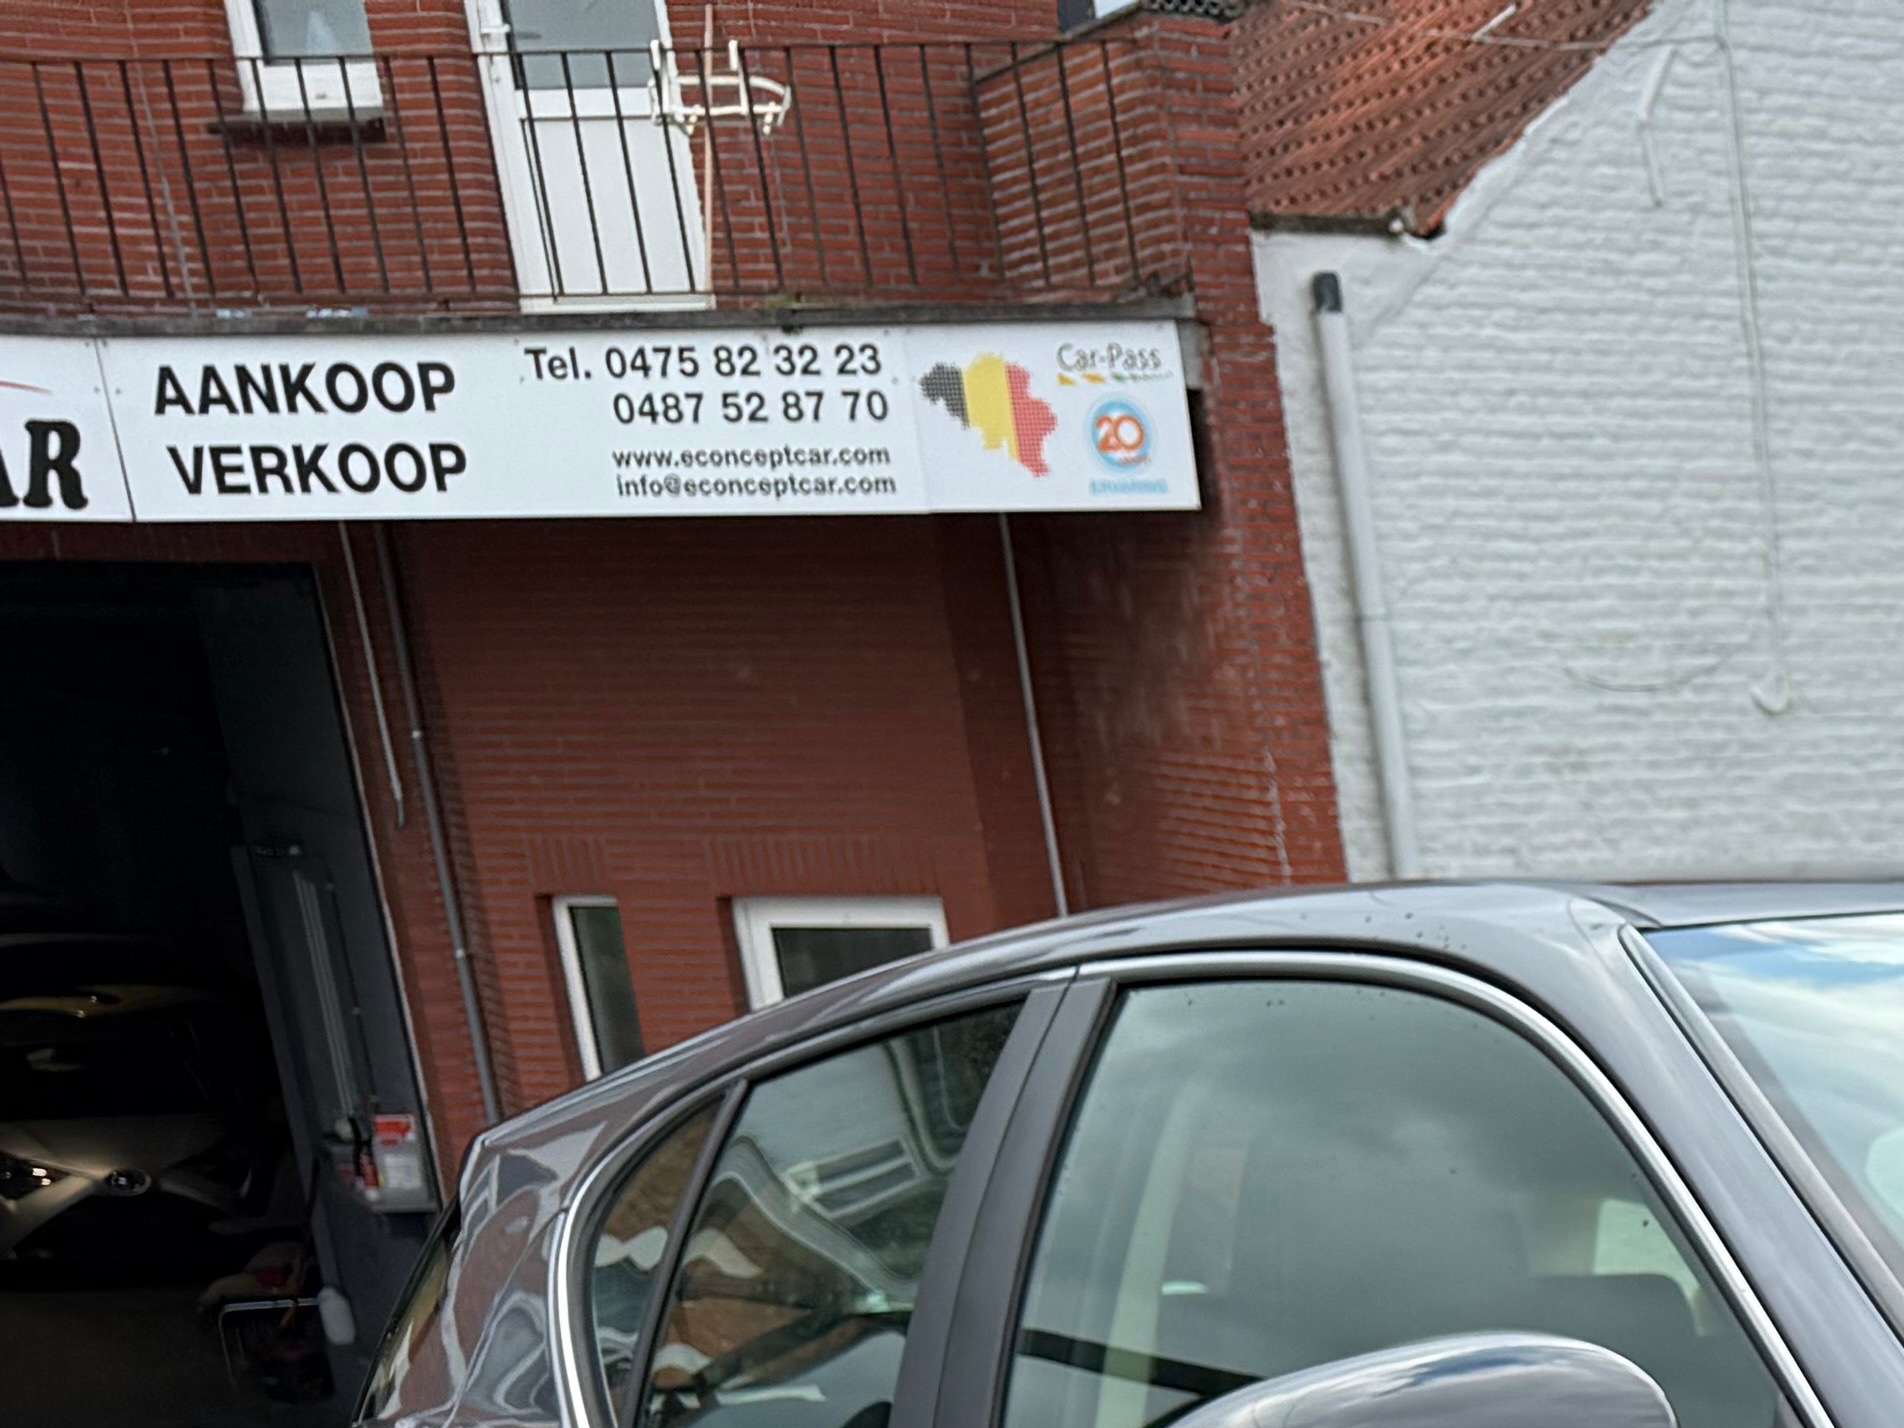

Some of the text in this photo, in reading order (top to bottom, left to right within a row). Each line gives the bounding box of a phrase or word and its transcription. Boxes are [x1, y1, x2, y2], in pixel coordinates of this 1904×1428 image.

[524, 344, 882, 380] Tel. 0475 82 32 23
[1056, 342, 1162, 371] Car-Pass
[154, 361, 456, 415] AANKOOP
[613, 389, 888, 425] 0487 52 87 70
[166, 441, 467, 495] VERKOOP
[612, 444, 890, 471] www.econceptcar.com
[616, 472, 897, 501] info@econceptcar.com
